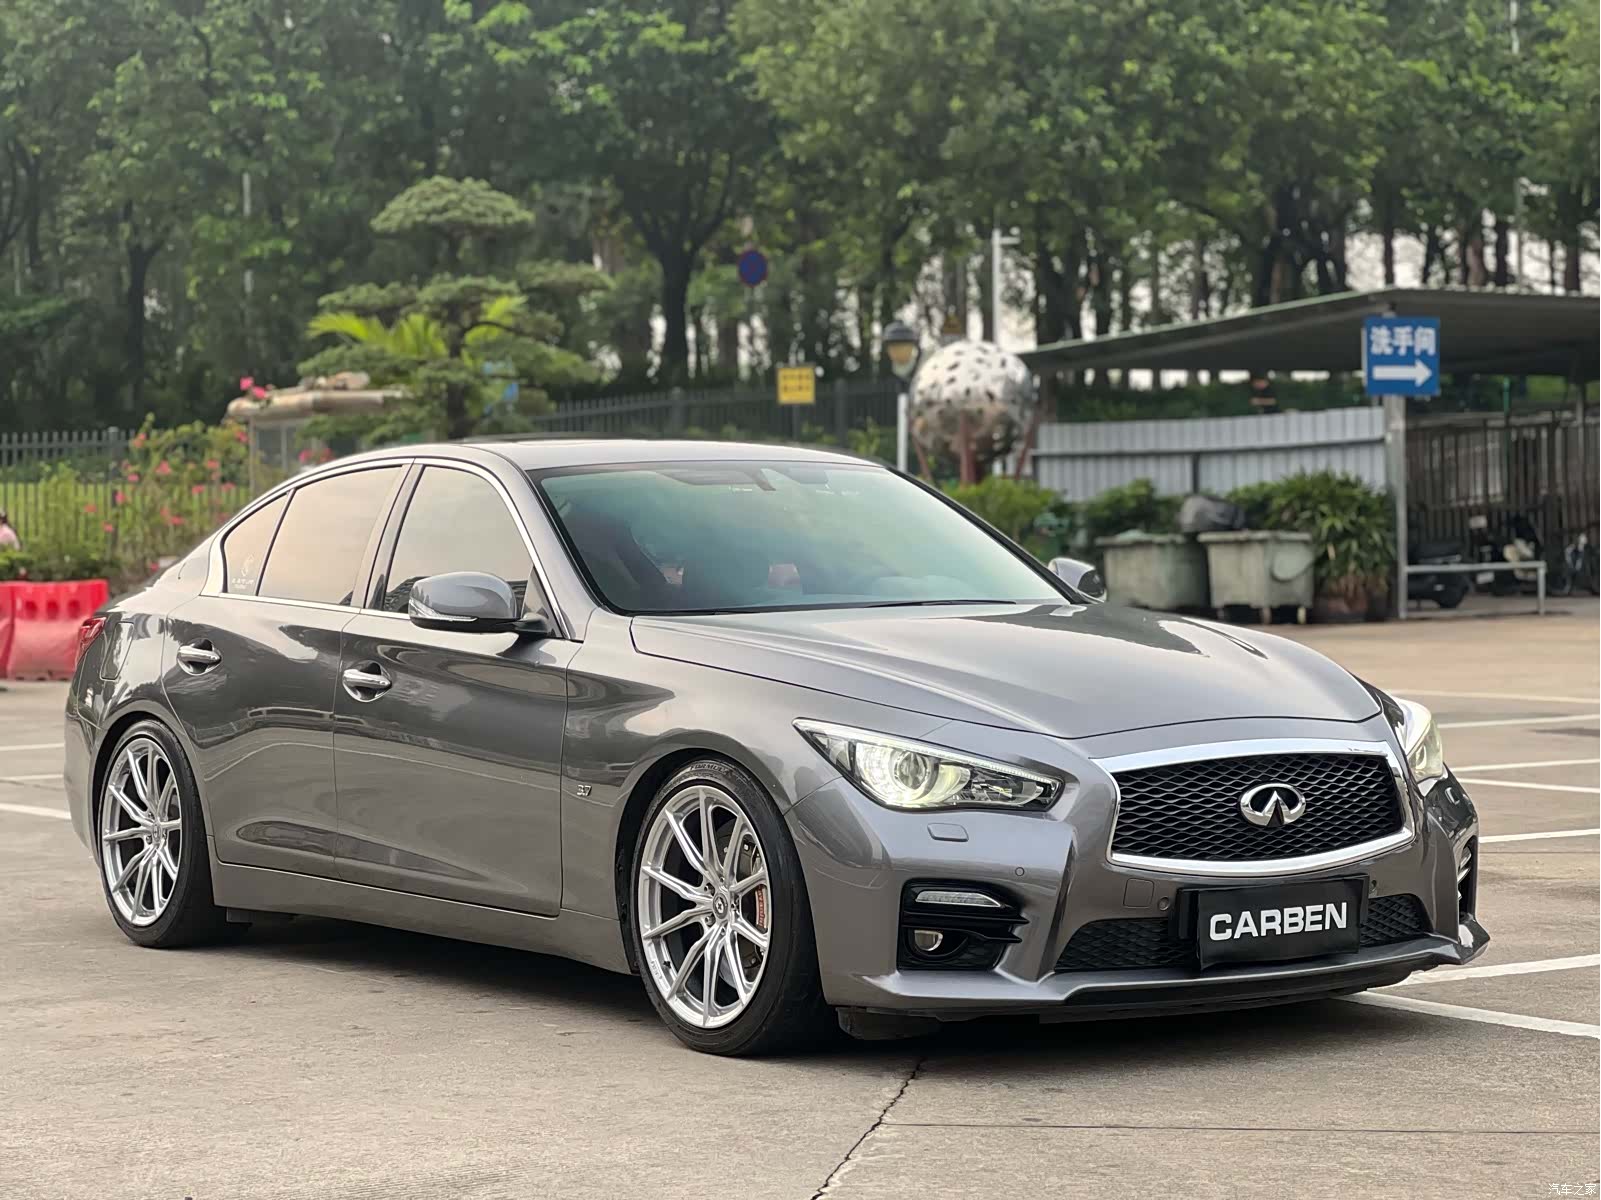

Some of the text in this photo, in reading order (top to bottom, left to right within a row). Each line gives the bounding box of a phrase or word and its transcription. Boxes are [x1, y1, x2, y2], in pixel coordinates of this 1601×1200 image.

[1370, 325, 1436, 356] 洗手间
[1209, 902, 1347, 941] CARBEN
